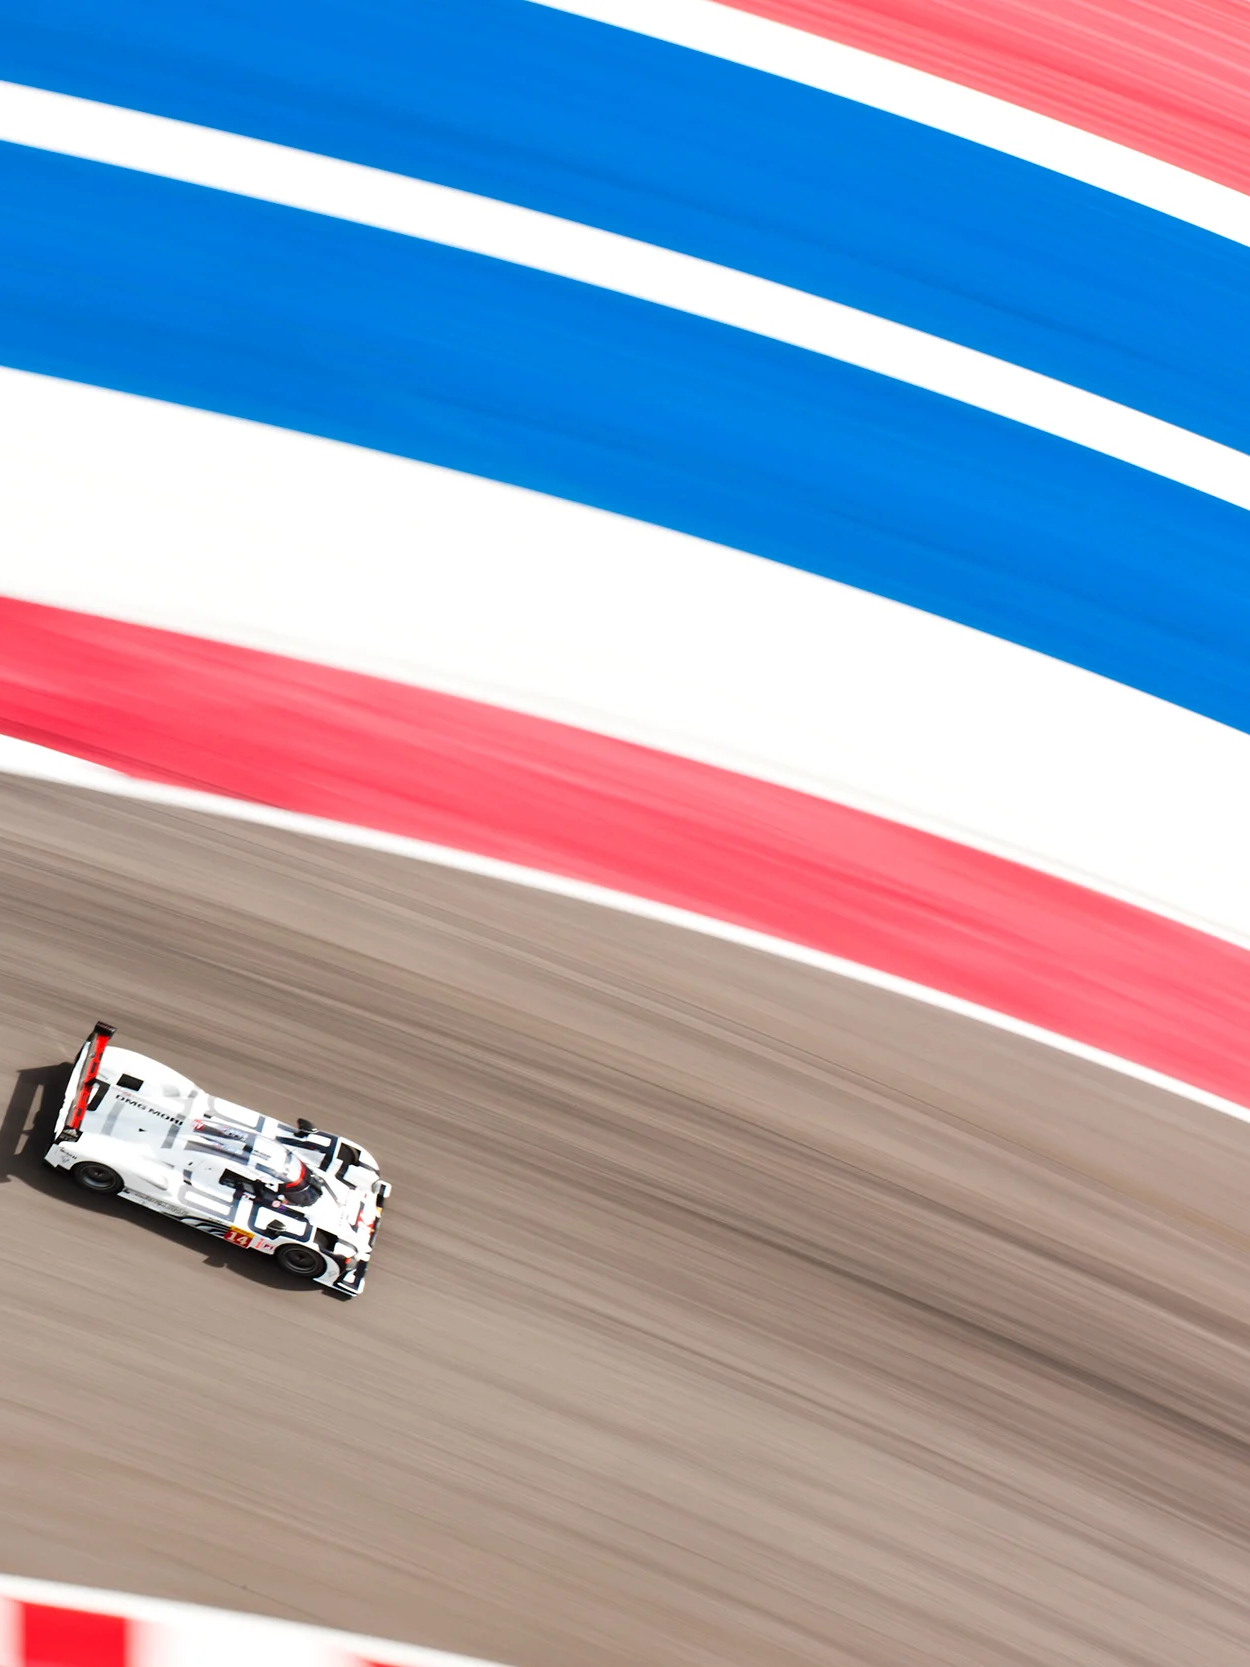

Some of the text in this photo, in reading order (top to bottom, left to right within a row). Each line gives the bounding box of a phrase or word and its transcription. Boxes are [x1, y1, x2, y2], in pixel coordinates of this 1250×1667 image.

[115, 1094, 146, 1110] DMG
[148, 1108, 184, 1126] MORI
[227, 1231, 248, 1246] 14
